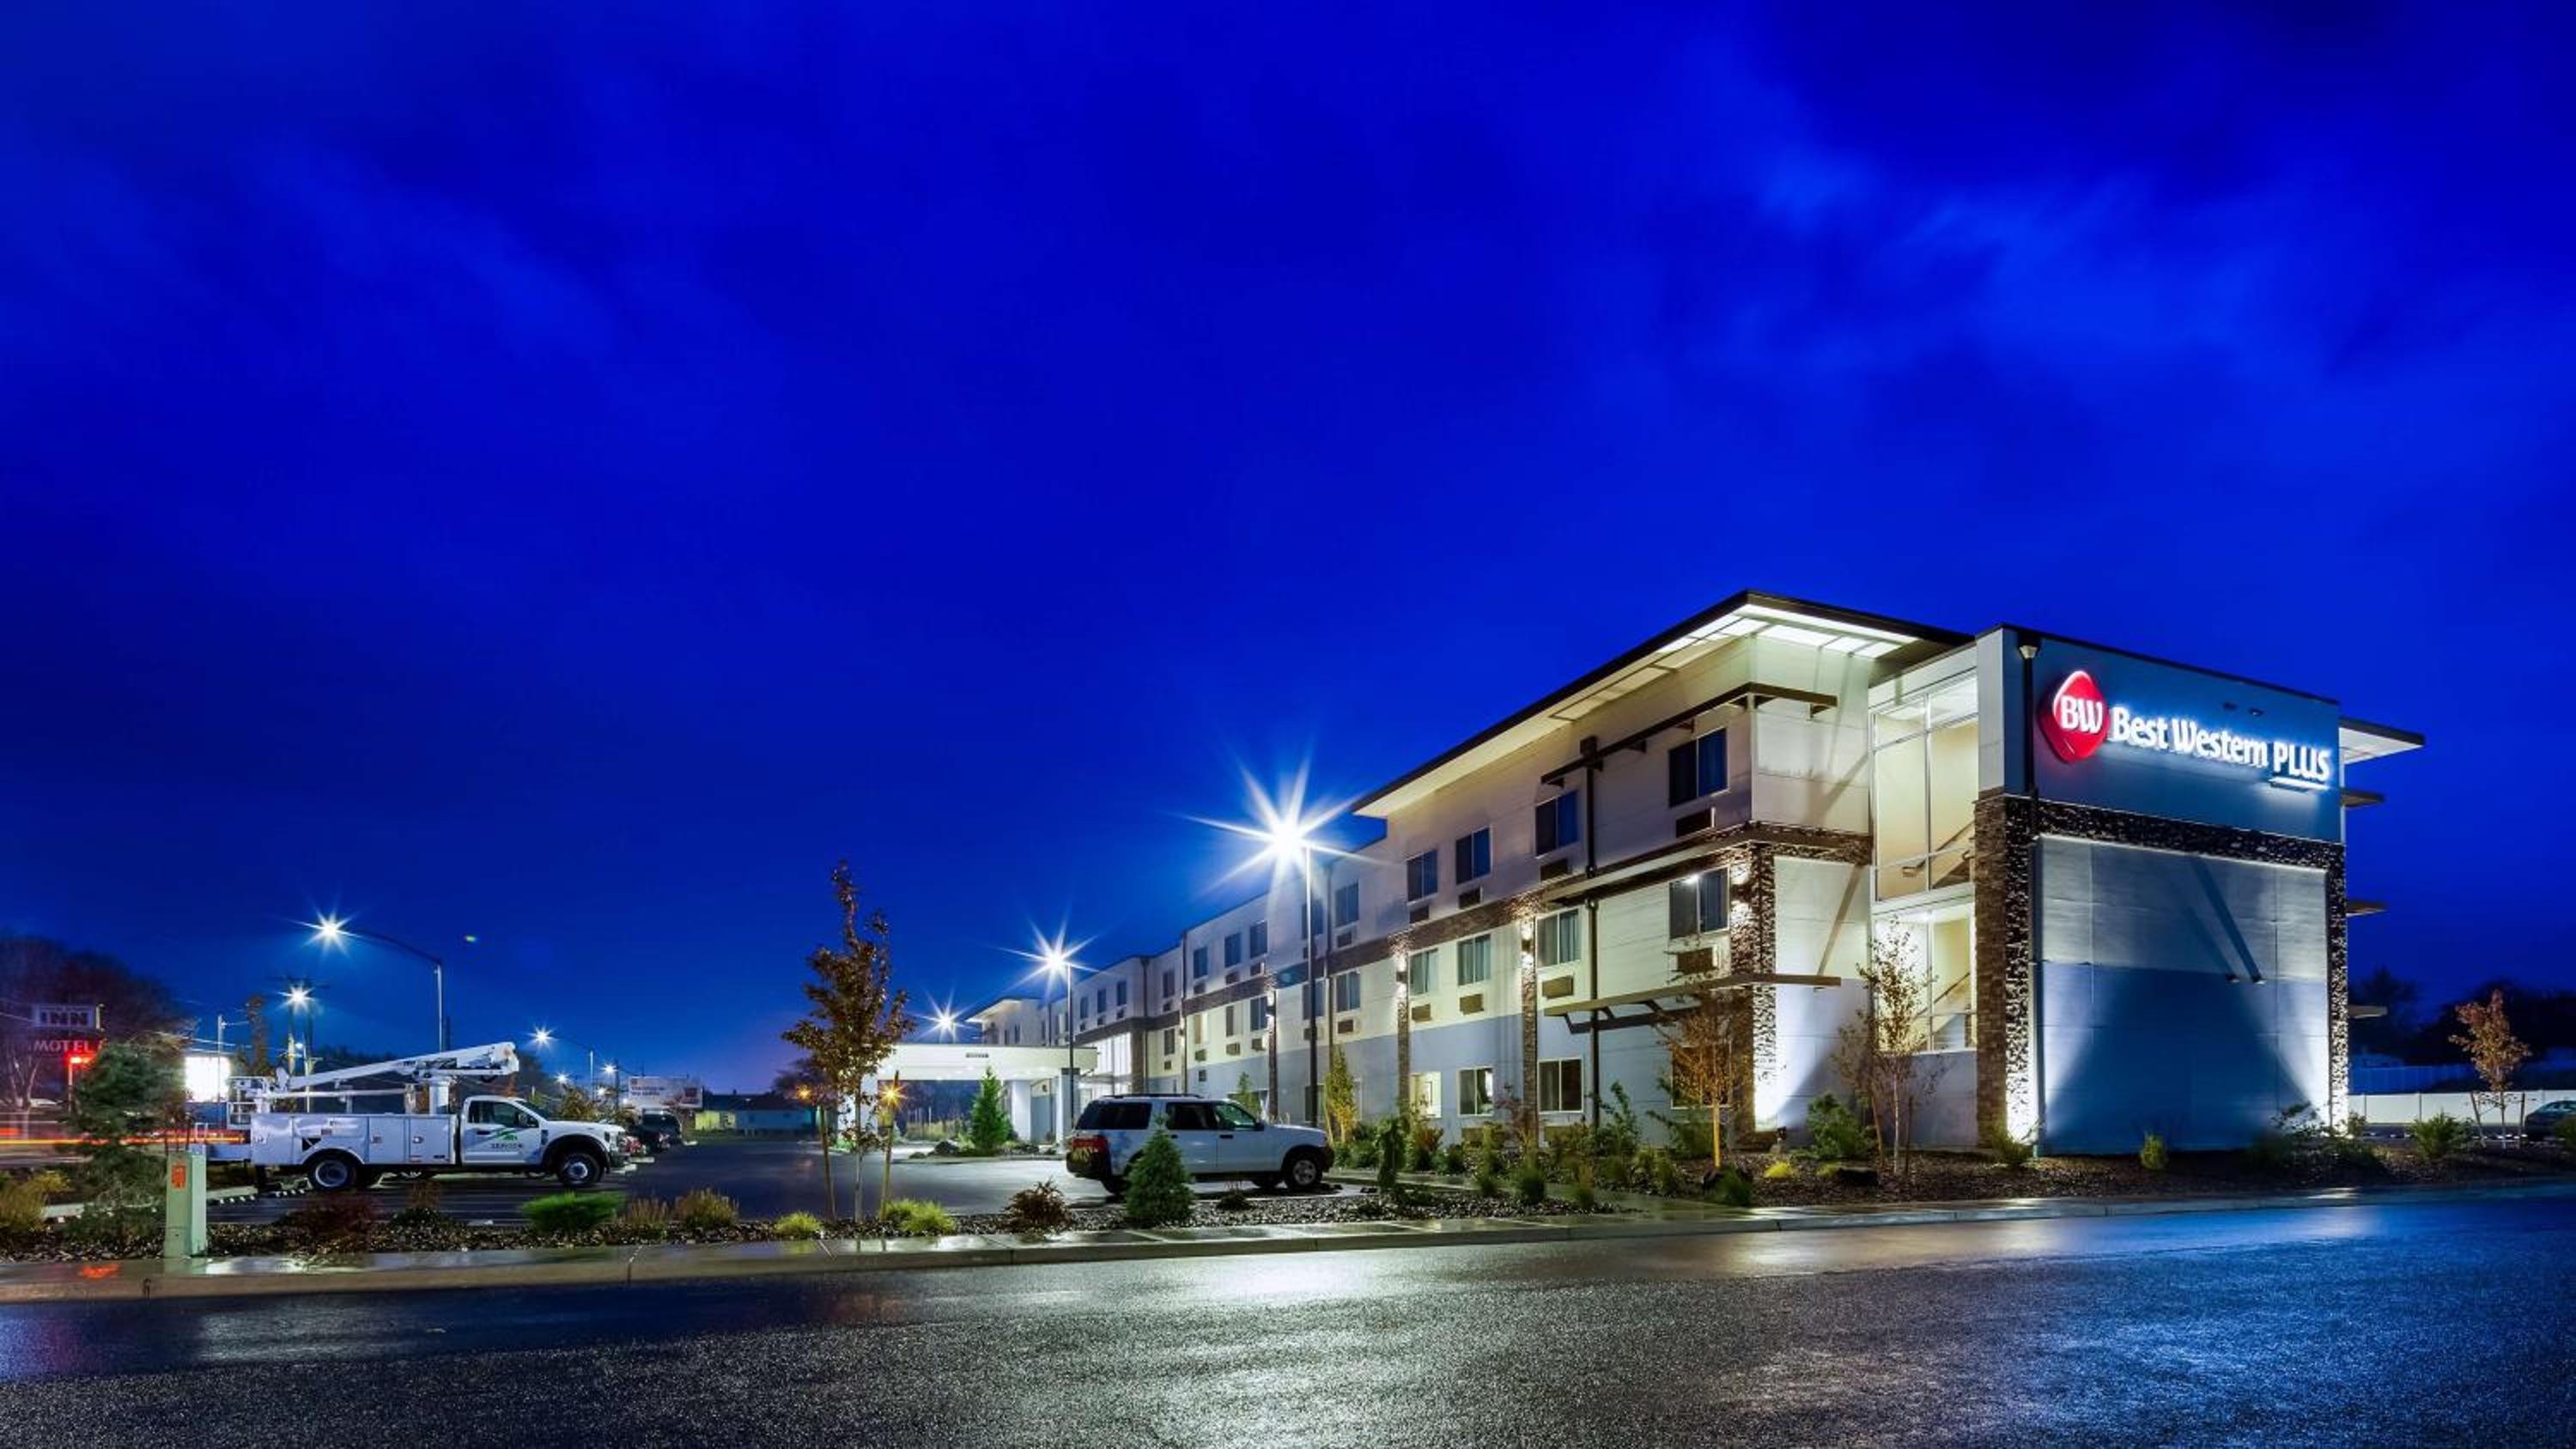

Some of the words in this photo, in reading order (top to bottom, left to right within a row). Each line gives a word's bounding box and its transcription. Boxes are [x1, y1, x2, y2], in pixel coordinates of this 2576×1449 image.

[2061, 696, 2103, 733] BW
[2111, 706, 2168, 749] Best
[2171, 718, 2269, 767] Western
[2273, 742, 2330, 780] PLUS
[40, 1012, 88, 1025] INN
[34, 1040, 91, 1052] MOTEL
